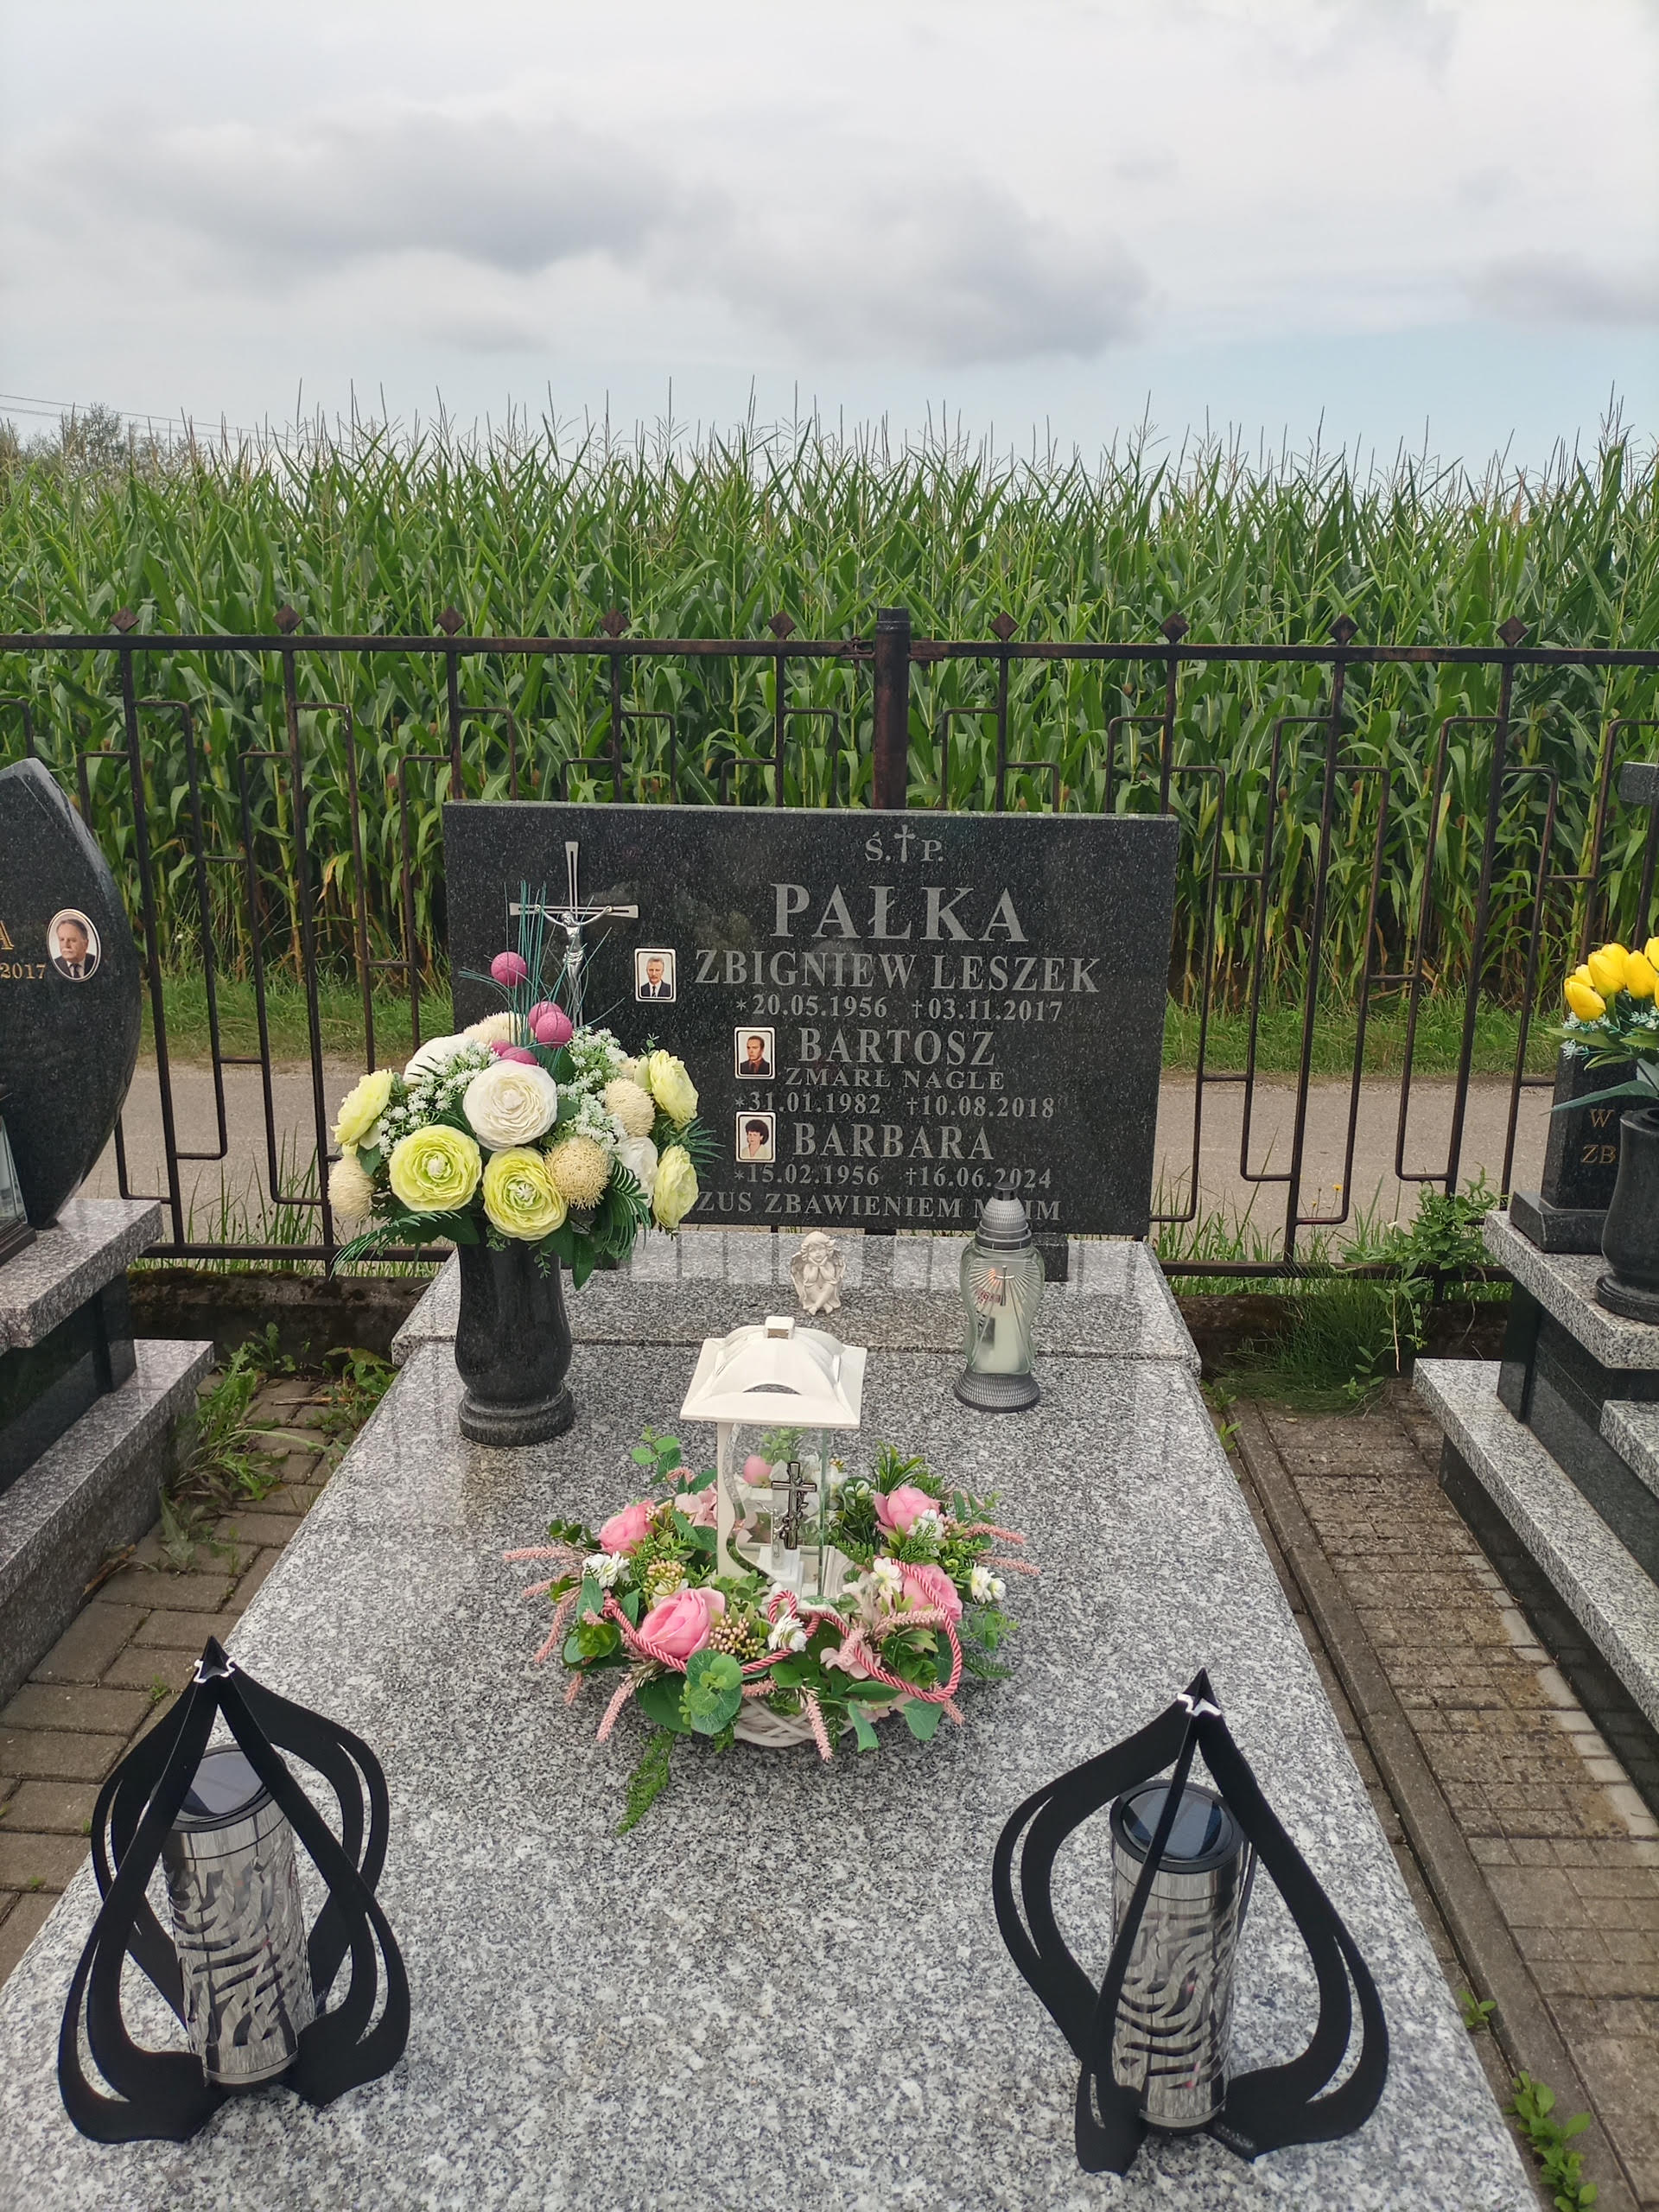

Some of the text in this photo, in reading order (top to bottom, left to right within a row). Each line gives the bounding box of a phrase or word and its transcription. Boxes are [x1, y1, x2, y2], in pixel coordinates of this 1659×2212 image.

[770, 882, 1029, 942] PAŁKA
[694, 950, 1100, 993] ZBIGNIEW LESZEK
[798, 1027, 995, 1065] BARTOSZ
[785, 1067, 1005, 1090] ZMARŁ NAGLE
[792, 1122, 995, 1160] BARBARA
[696, 1191, 752, 1212] ZUS
[765, 1193, 963, 1218] ZBAWIENIEM
